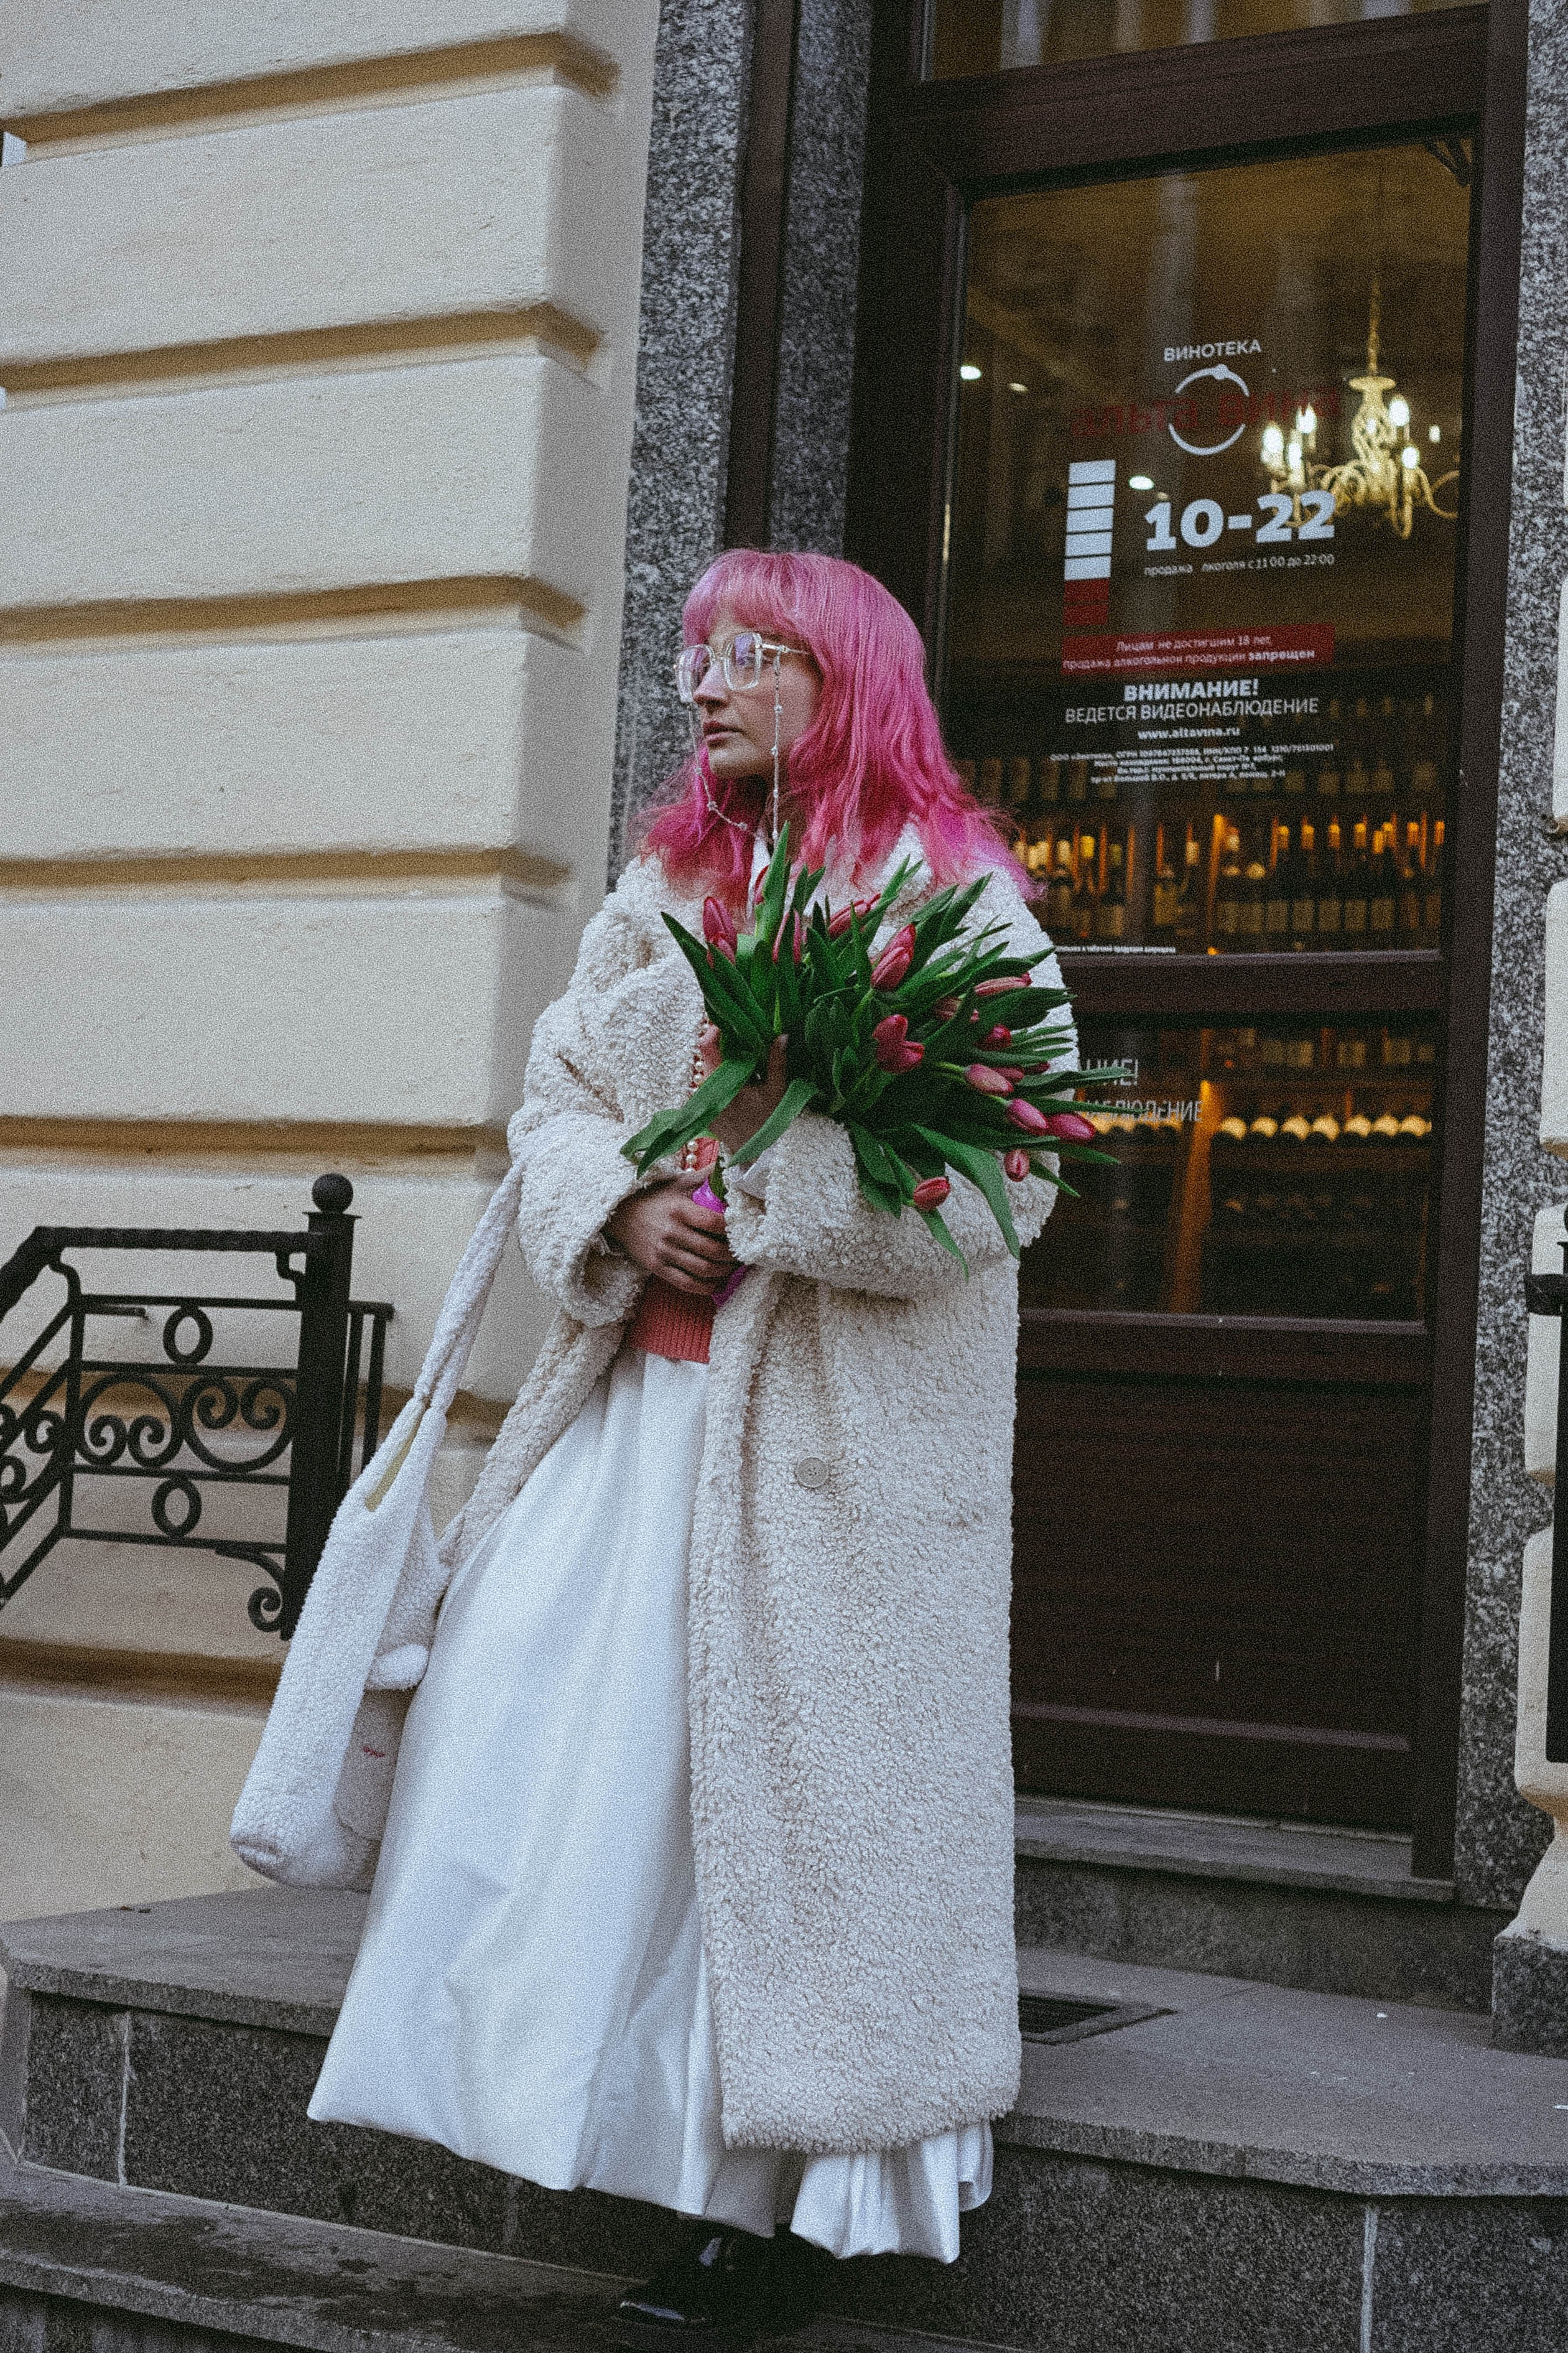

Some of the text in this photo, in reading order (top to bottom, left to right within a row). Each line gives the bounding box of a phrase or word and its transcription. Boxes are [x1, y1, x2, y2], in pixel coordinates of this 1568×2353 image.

[1164, 339, 1261, 362] ВИНОТЕКА
[1144, 490, 1336, 551] 10-22
[1144, 564, 1193, 577] продажа
[1116, 641, 1154, 653] Лицам
[1159, 641, 1171, 650] не
[1239, 636, 1250, 646] 18
[1062, 658, 1111, 669] продажа
[1248, 650, 1315, 663] запрещен
[1124, 679, 1259, 701] ВНИМАНИЕ!
[1065, 697, 1319, 724] ВЕДЕТСЯ ВИДЕОНАБЛЮДЕНИЕ
[1138, 727, 1240, 739] www.altavina.ru
